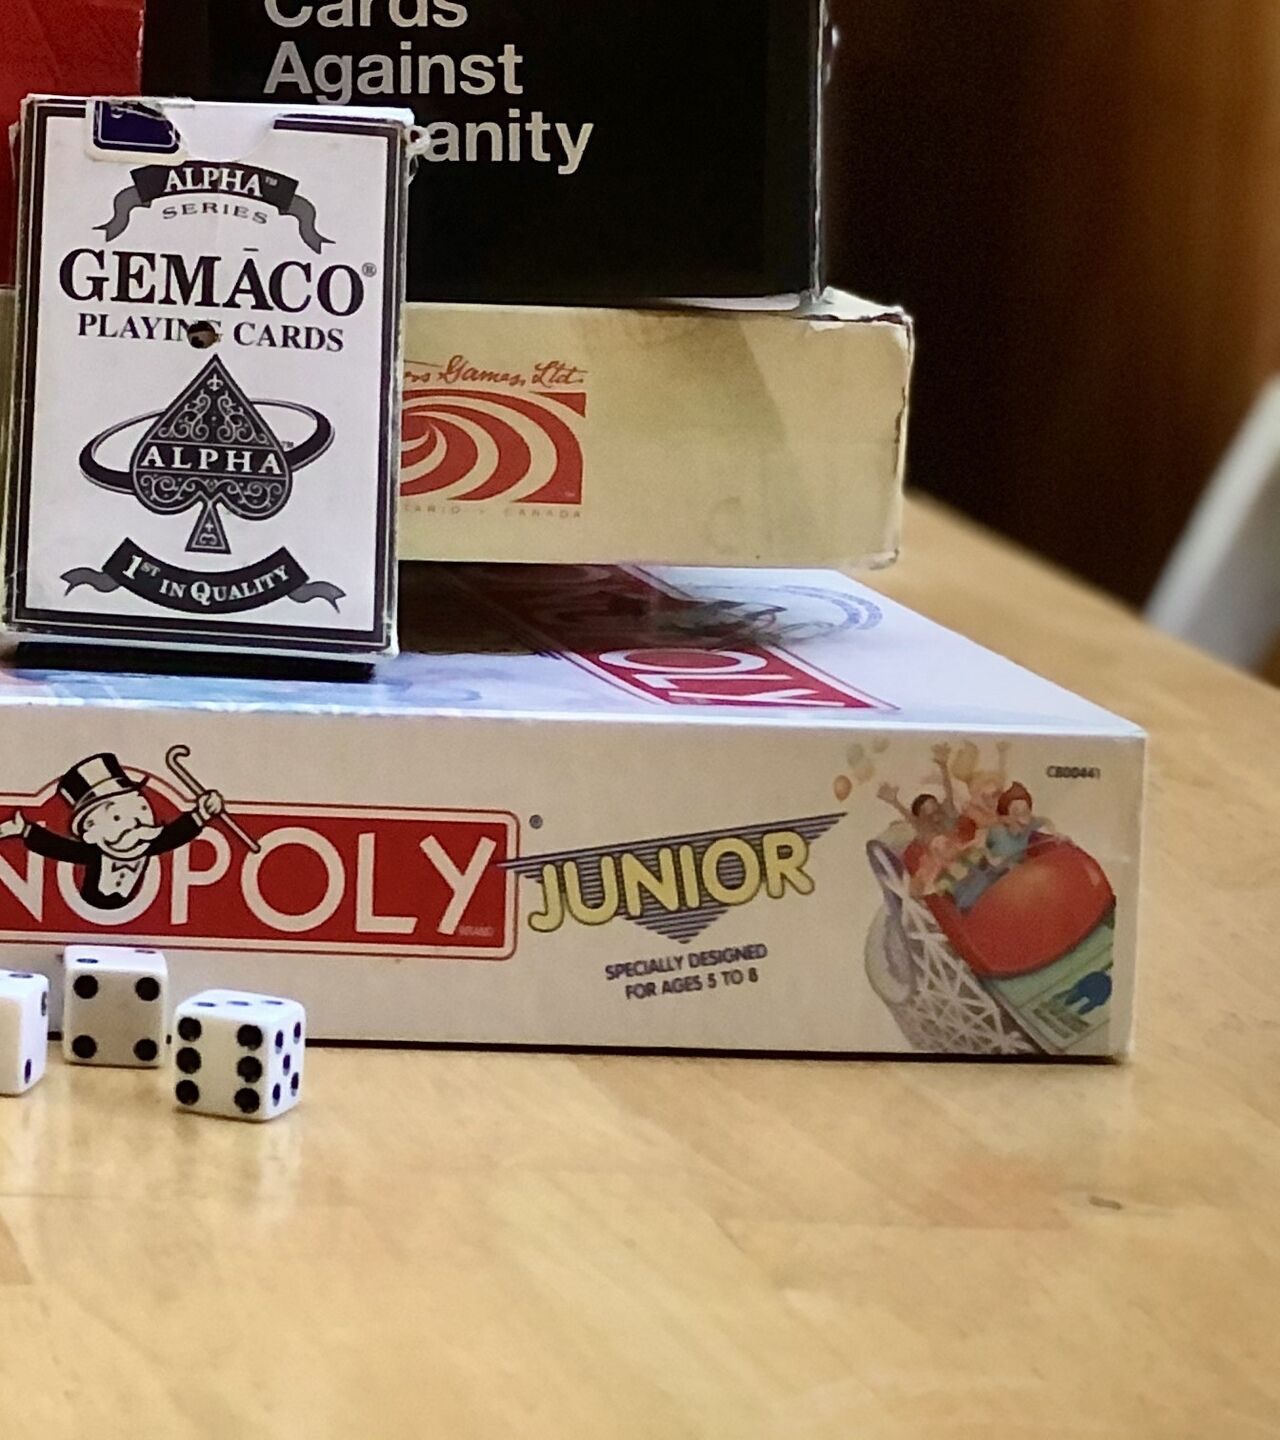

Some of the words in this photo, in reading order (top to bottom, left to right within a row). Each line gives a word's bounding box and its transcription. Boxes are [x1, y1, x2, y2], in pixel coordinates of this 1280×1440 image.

[263, 41, 523, 105] Against
[423, 109, 594, 175] anity
[164, 167, 263, 197] ALPHA
[162, 202, 268, 225] SERIES
[234, 322, 344, 353] CARDS
[141, 445, 283, 475] ALPHA
[159, 579, 187, 598] IN
[191, 564, 290, 606] QUALITY
[528, 830, 816, 933] JUNIOR
[605, 955, 683, 981] SPECIALLY
[688, 944, 768, 968] DESIGNED
[625, 982, 656, 999] FOR
[662, 975, 703, 995] AGES
[707, 973, 717, 988] 5
[721, 969, 743, 986] TO
[748, 967, 758, 983] 8
